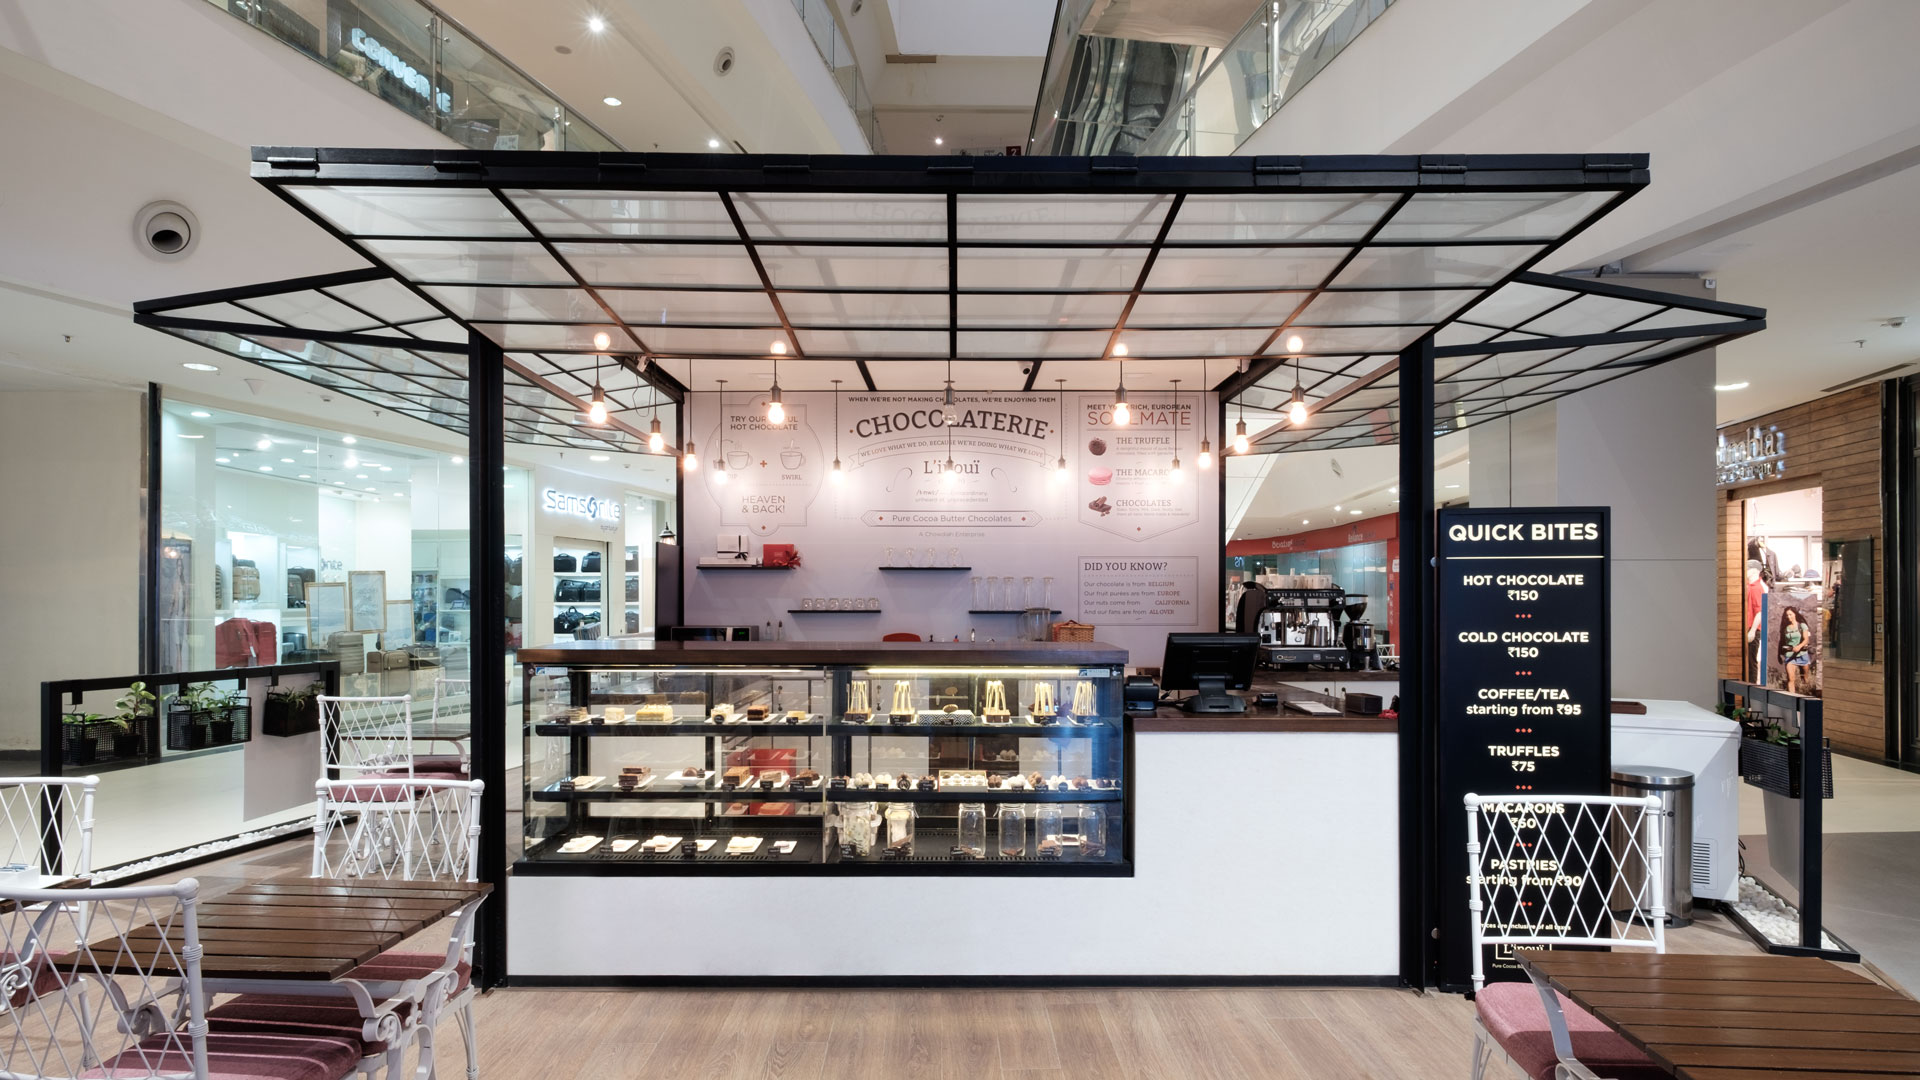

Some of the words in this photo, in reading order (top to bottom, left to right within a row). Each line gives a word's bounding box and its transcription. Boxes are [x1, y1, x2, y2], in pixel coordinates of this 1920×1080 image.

[934, 396, 981, 404] CHOLATES,
[730, 415, 746, 423] TRY
[748, 415, 767, 423] OUR
[1087, 411, 1192, 426] SOLMATE
[730, 423, 747, 431] HOT
[1116, 437, 1132, 445] THE
[1134, 437, 1171, 445] TRUFFLE
[871, 447, 887, 455] LOVE
[887, 443, 906, 451] WHAT
[977, 441, 998, 449] DOING
[998, 443, 1017, 452] WHAT
[1018, 446, 1028, 454] WE
[1028, 449, 1044, 458] LOVE
[923, 459, 981, 475] L'iouï
[1116, 468, 1133, 476] THE
[742, 495, 786, 504] HEAVEN
[1116, 499, 1172, 507] CHOCOLATES
[741, 505, 749, 514] &
[752, 505, 786, 514] BACK!
[892, 514, 911, 523] Pure
[912, 514, 938, 523] Cocoa
[940, 514, 966, 523] Butter
[967, 514, 1012, 523] Chocolates
[1448, 523, 1525, 542] QUICK
[1531, 523, 1599, 541] BITES
[1084, 562, 1103, 571] DID
[1106, 562, 1127, 571] YOU
[1130, 562, 1168, 571] KNOW?
[1463, 575, 1493, 586] HOT
[1496, 574, 1584, 586] CHOCOLATE
[1507, 590, 1539, 601] ₹150
[1458, 632, 1498, 643] COLD
[1501, 631, 1590, 643] CHOCOLATE
[1507, 647, 1539, 658] ₹150
[1478, 688, 1570, 701] COFFEE/TEA
[1466, 704, 1518, 716] starting
[1521, 703, 1554, 715] from
[1556, 704, 1582, 716] ₹95
[1488, 745, 1560, 757] TRUFFLES
[1511, 760, 1536, 772] ₹75
[1483, 803, 1565, 814] MACARONS
[1466, 874, 1517, 887] sarting
[1521, 874, 1553, 885] from
